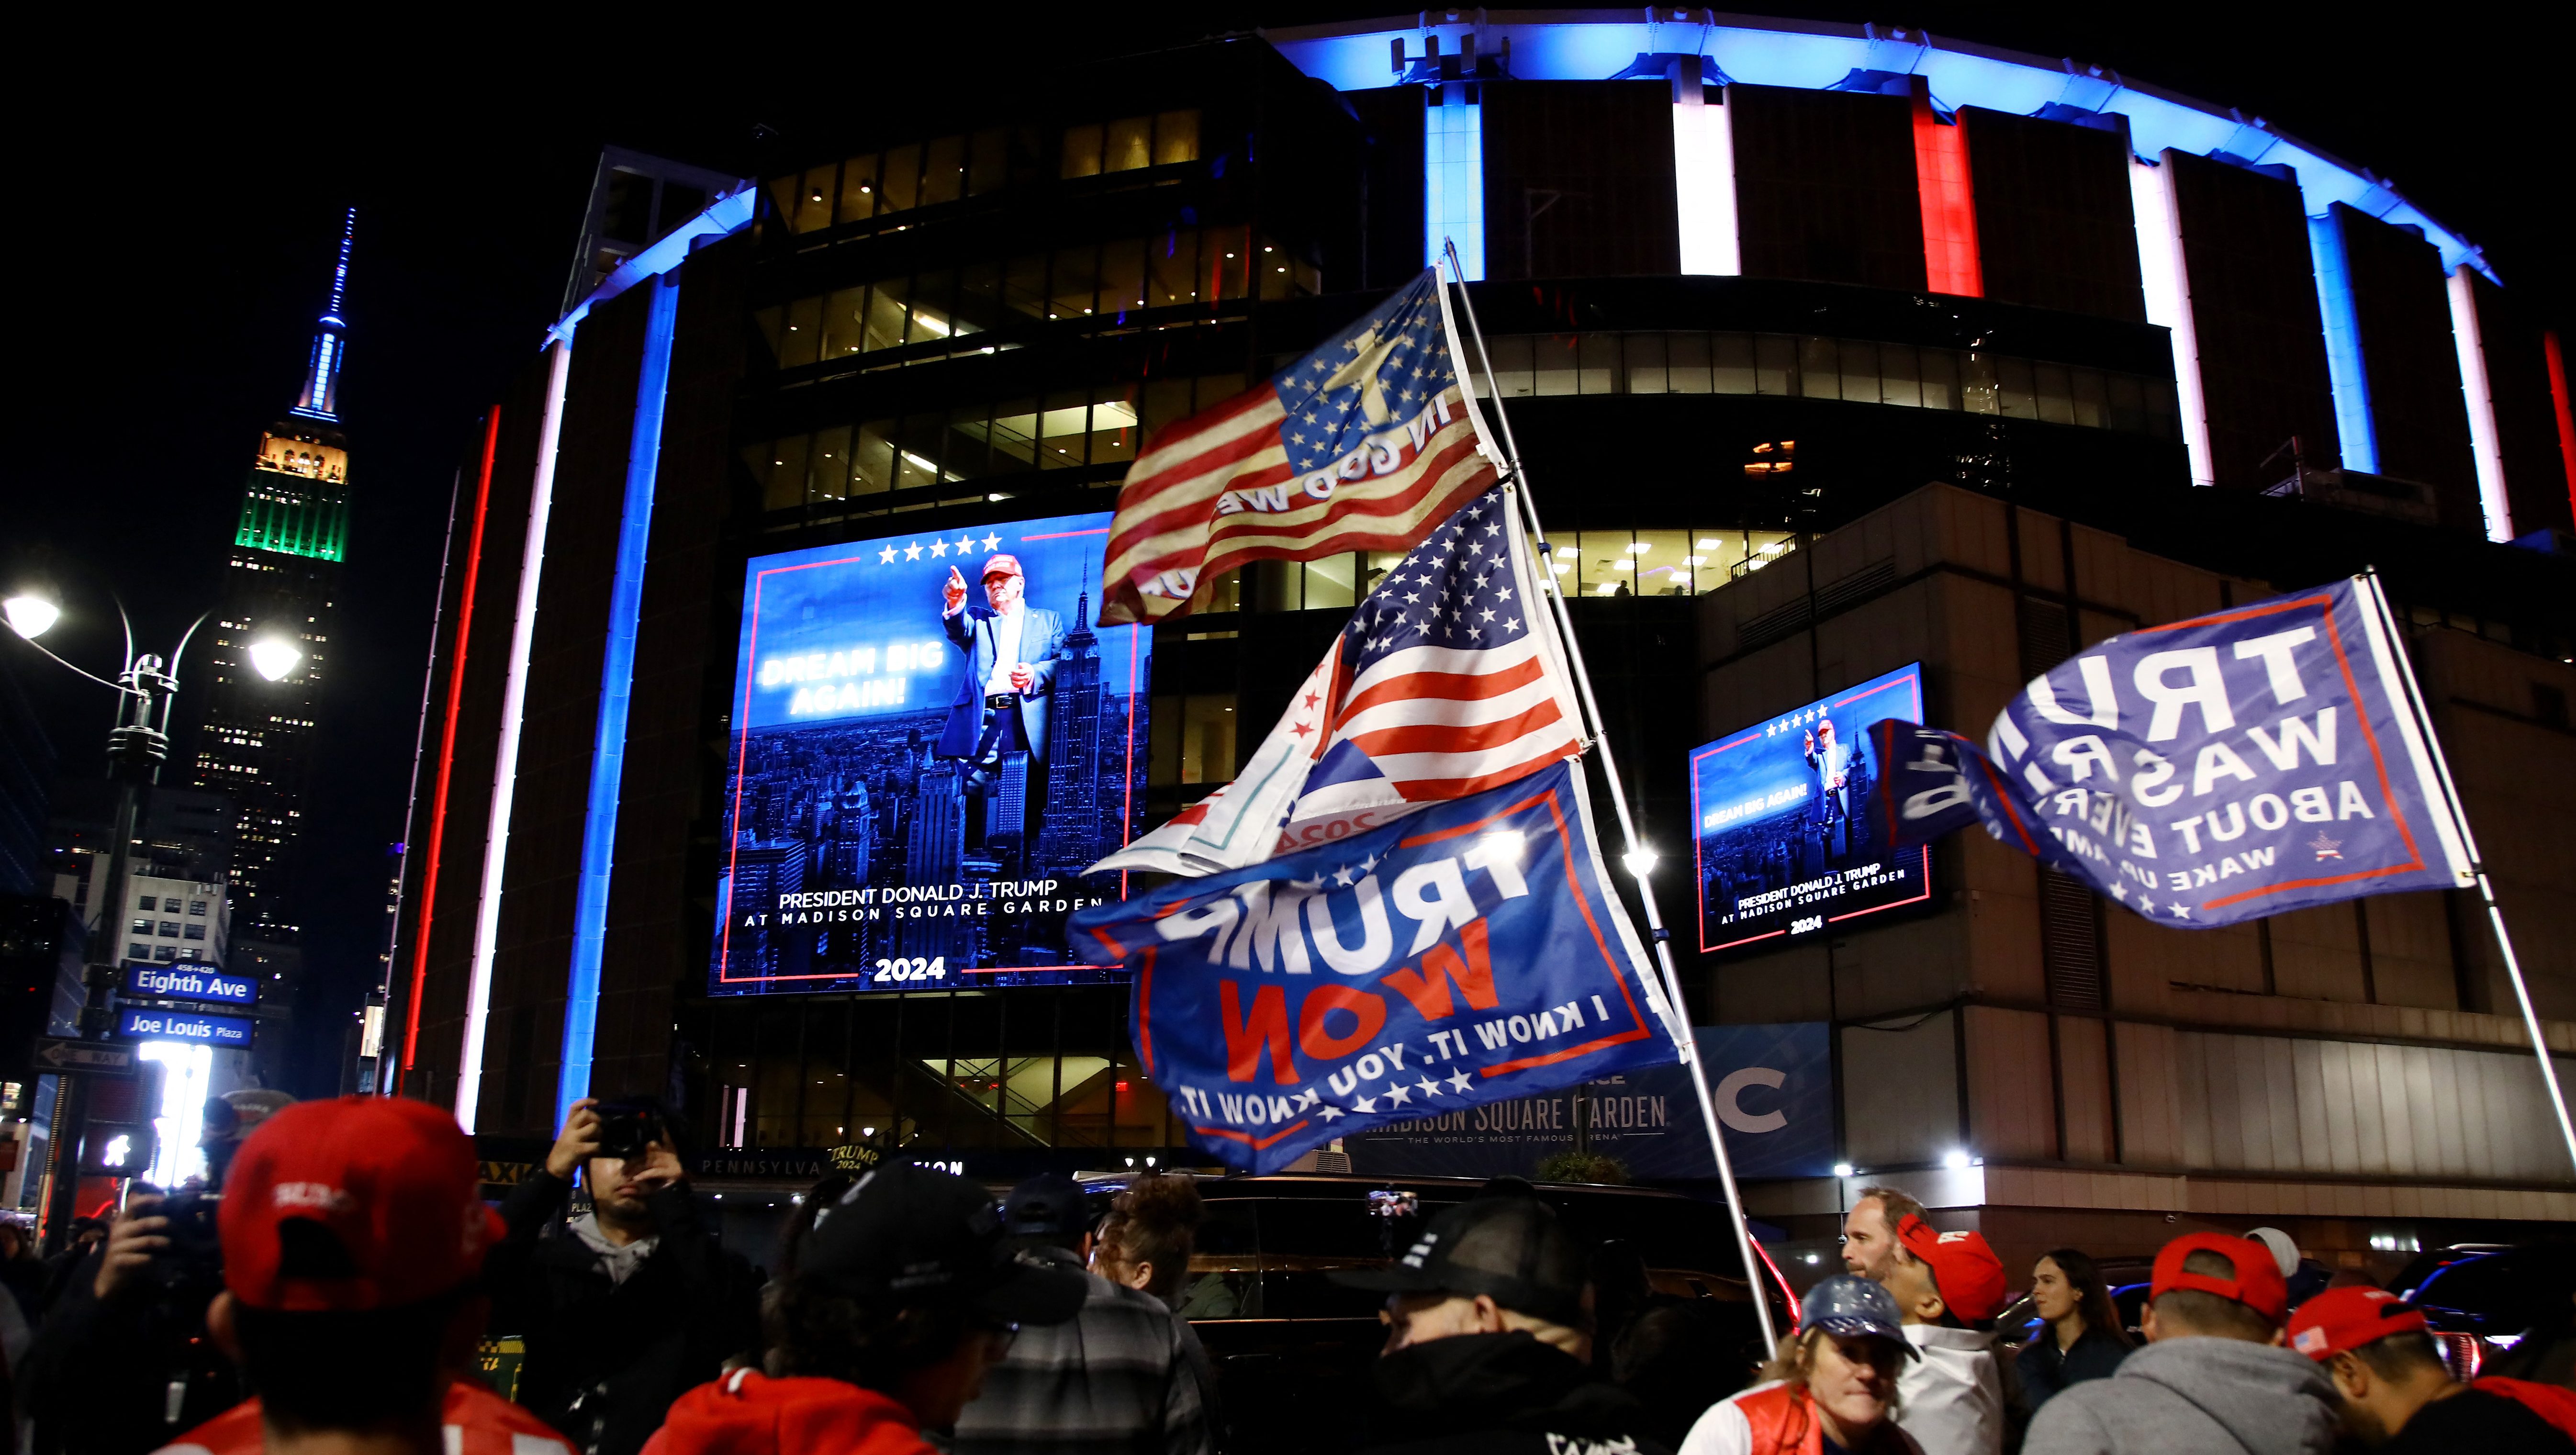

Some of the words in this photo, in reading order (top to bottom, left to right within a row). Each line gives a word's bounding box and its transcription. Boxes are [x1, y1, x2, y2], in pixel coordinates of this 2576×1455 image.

[762, 648, 875, 686] DREAM
[886, 641, 943, 672] BIG
[790, 677, 906, 715] AGAIN!
[1704, 805, 1743, 828] DREAM
[1745, 797, 1764, 814] BIG
[1767, 783, 1807, 807] AGAIN!
[779, 888, 878, 909] PRESIDENT
[882, 884, 963, 904] DONALD
[969, 883, 983, 899] J.
[988, 879, 1057, 898] TRUMP
[1722, 914, 1734, 925] AT
[1740, 899, 1792, 919] MADISON
[1798, 884, 1846, 905] SQUARE
[1853, 869, 1905, 890] GARDEN
[1738, 888, 1788, 910] PRESIDENT
[1790, 876, 1833, 897] DONALD
[1844, 863, 1881, 882] TRUMP
[745, 914, 768, 927] AT
[782, 908, 880, 925] MADISON
[895, 903, 987, 918] SQUARE
[1004, 898, 1102, 914] GARDEN
[1791, 915, 1823, 935] 2024
[874, 956, 946, 982] 2024
[137, 971, 203, 994] Eighth
[206, 978, 247, 997] Ave
[130, 1015, 162, 1033] Joe
[165, 1018, 212, 1038] Louis
[216, 1027, 243, 1039] Plaza
[1475, 1097, 1563, 1132] SQUARE
[1590, 1133, 1618, 1141] RENA
[830, 1145, 880, 1165] TRUMP
[836, 1161, 861, 1170] 2024
